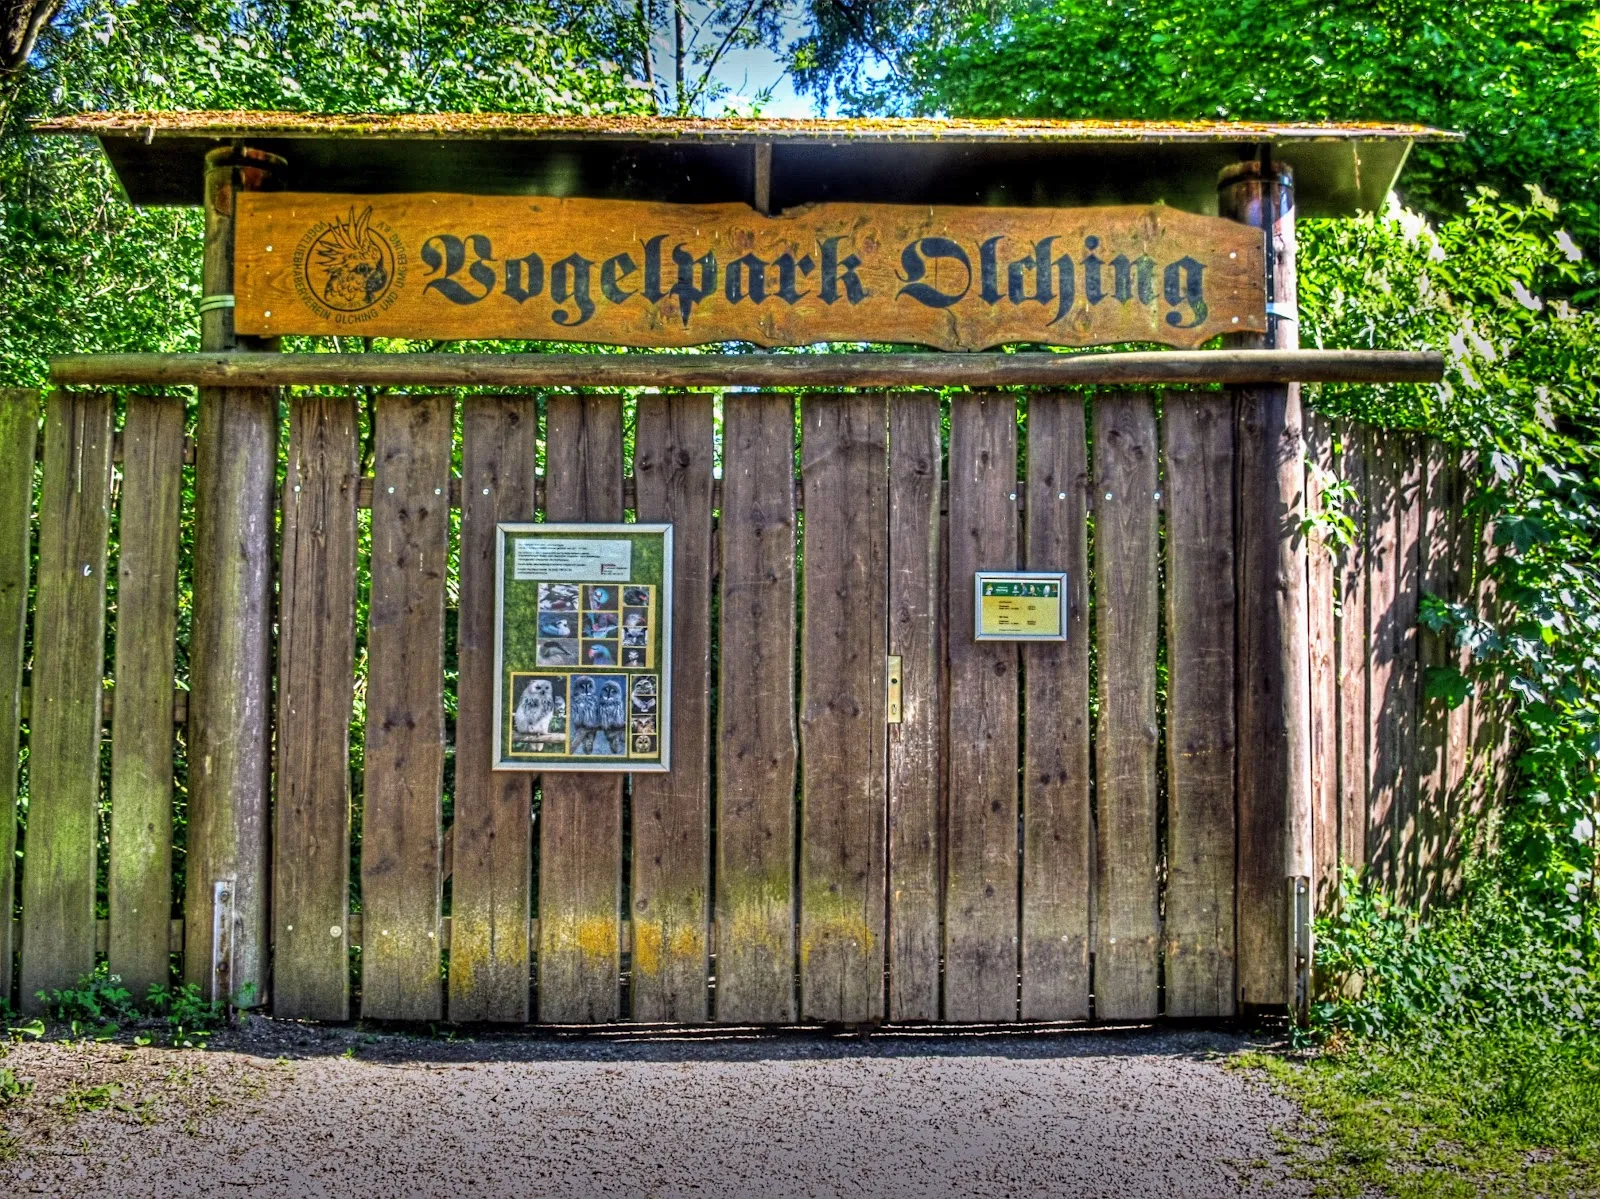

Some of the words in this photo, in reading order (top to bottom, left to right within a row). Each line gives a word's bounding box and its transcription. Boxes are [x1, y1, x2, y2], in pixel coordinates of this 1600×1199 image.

[389, 233, 408, 289] UMGEBUNG
[421, 233, 869, 328] Vogelpark
[894, 234, 1209, 329] Olching
[335, 309, 378, 324] OLCHING
[380, 291, 399, 311] UND
